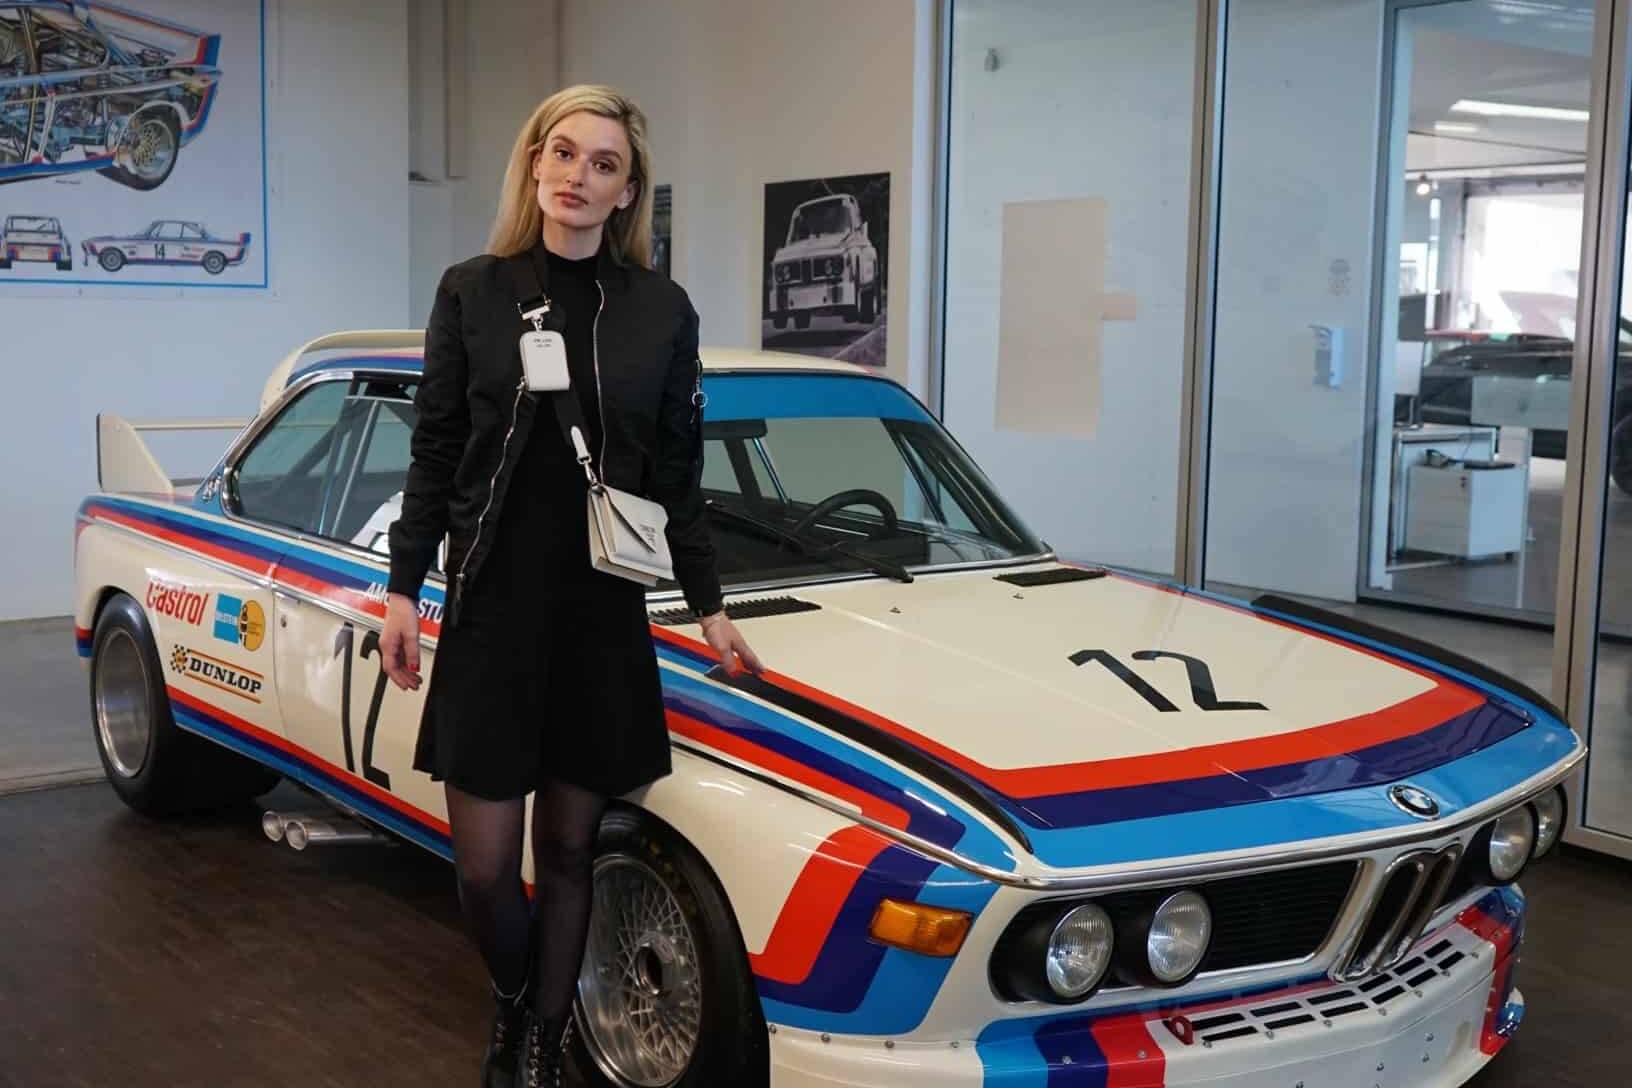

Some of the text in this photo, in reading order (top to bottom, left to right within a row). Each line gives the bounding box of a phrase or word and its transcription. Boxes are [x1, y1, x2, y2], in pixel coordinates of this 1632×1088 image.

[154, 243, 165, 260] 14
[146, 581, 208, 626] Castrol
[416, 597, 445, 624] STU
[189, 657, 263, 693] DUNLOP
[1067, 649, 1270, 712] 12
[334, 621, 392, 791] 12
